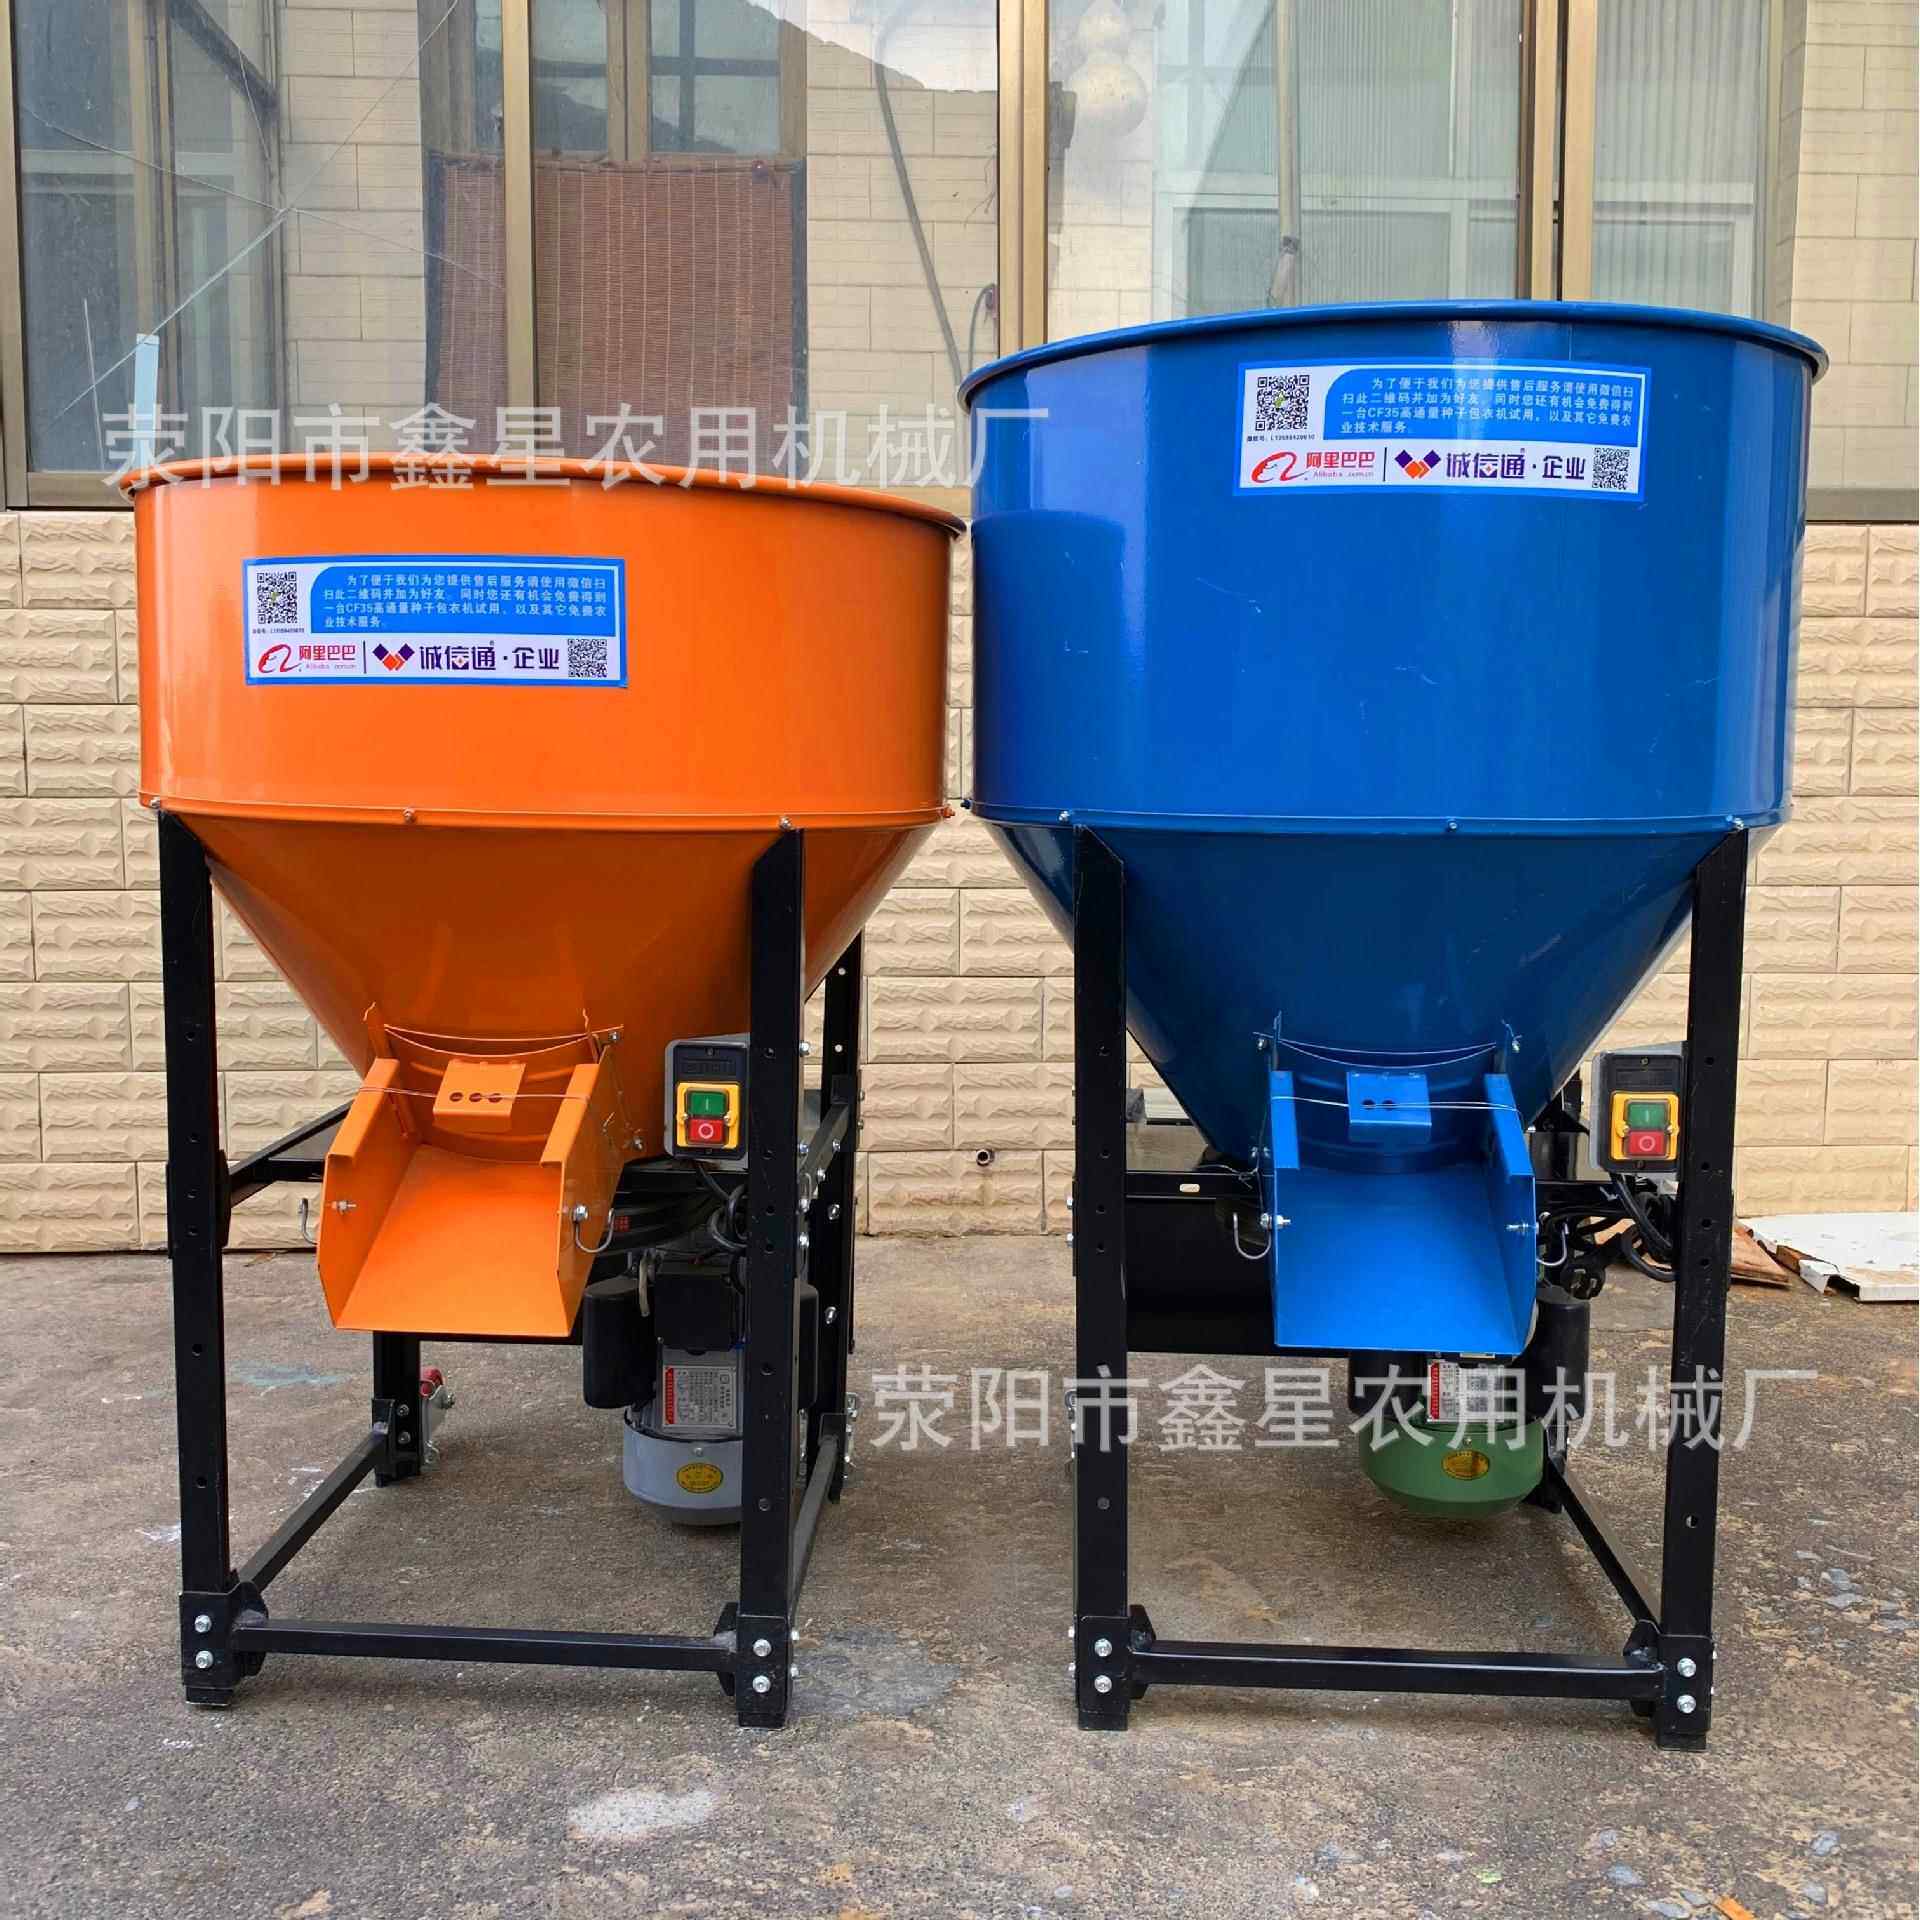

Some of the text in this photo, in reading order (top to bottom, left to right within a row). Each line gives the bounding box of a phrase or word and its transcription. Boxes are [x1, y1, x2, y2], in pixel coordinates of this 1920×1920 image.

[1306, 451, 1375, 468] 阿里巴巴
[298, 645, 356, 661] 阿里巴巴
